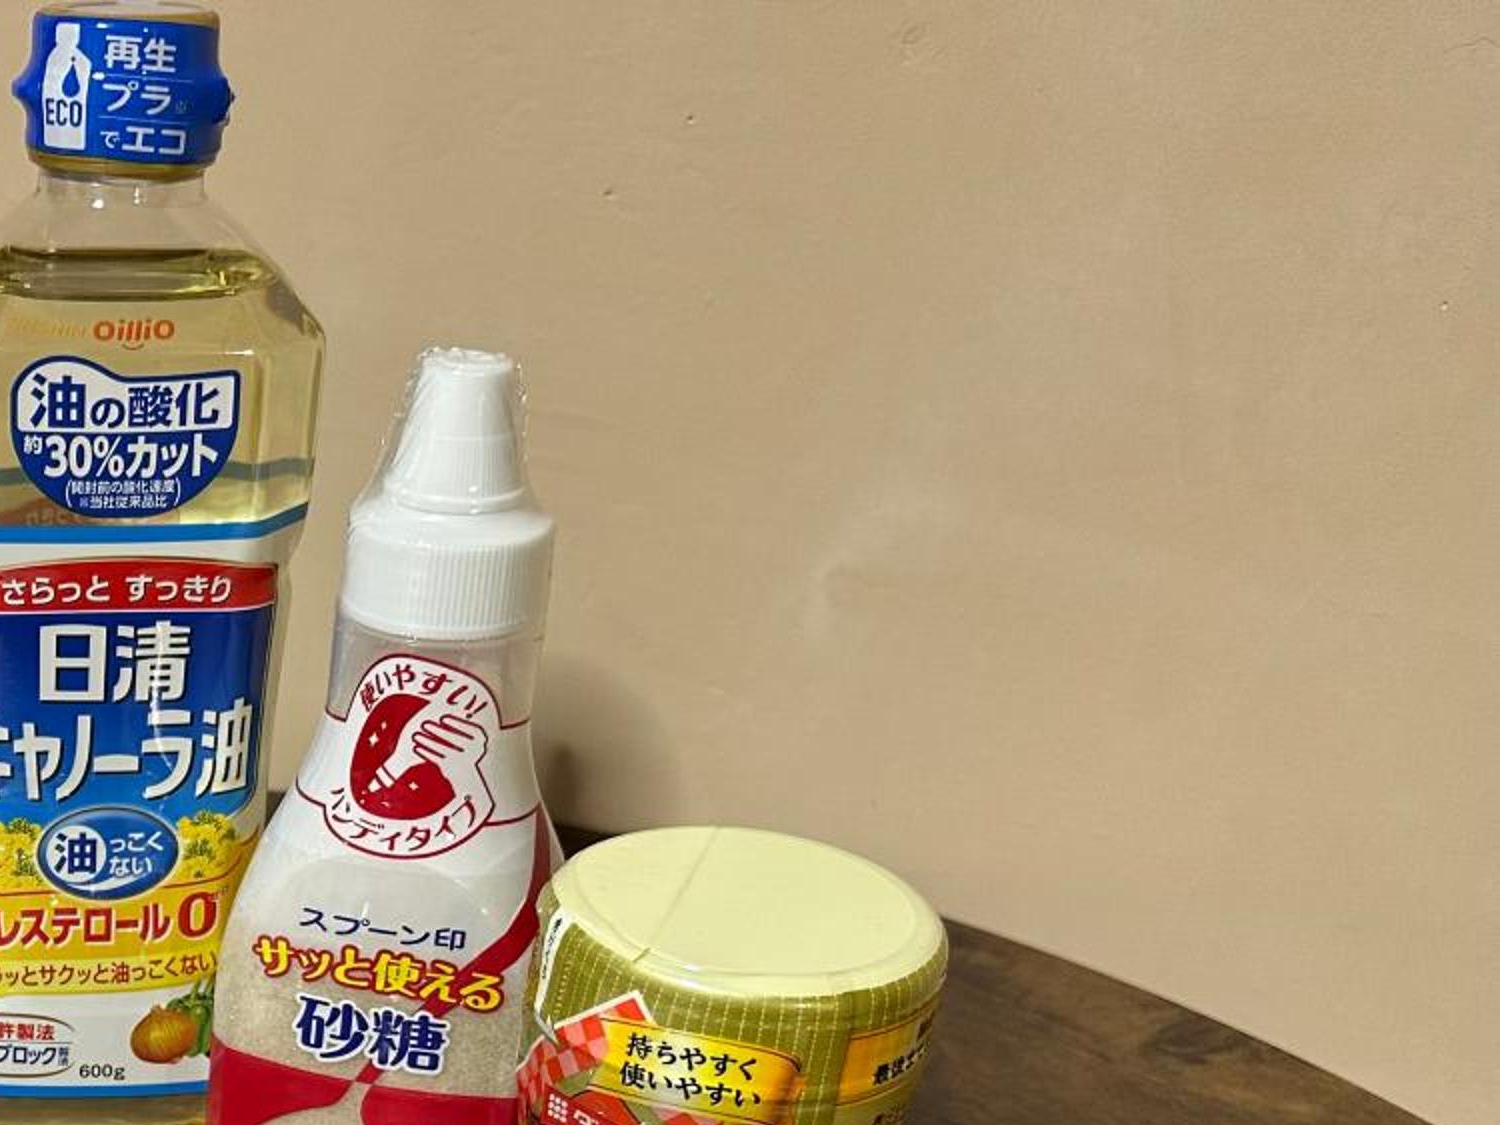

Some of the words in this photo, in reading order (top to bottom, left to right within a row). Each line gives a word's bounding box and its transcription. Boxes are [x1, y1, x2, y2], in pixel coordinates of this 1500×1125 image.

[104, 34, 177, 73] 再生
[45, 97, 83, 128] ECO
[102, 81, 172, 115] プラ
[100, 125, 187, 155] でエコ
[29, 373, 220, 429] 油の酸化
[24, 433, 219, 479] 約30%カット
[1, 577, 110, 606] さらっと
[125, 574, 232, 602] すっきり
[39, 620, 192, 702] 日清
[359, 663, 488, 719] 使いやすい!
[330, 786, 478, 852] ハンディタイプ
[300, 907, 467, 951] スプーン印
[253, 935, 506, 1012] サッと使える
[296, 994, 448, 1073] 砂糖
[626, 1032, 760, 1081] 持ちやすく
[79, 1063, 126, 1081] 600g
[620, 1061, 762, 1108] 使いやすい
